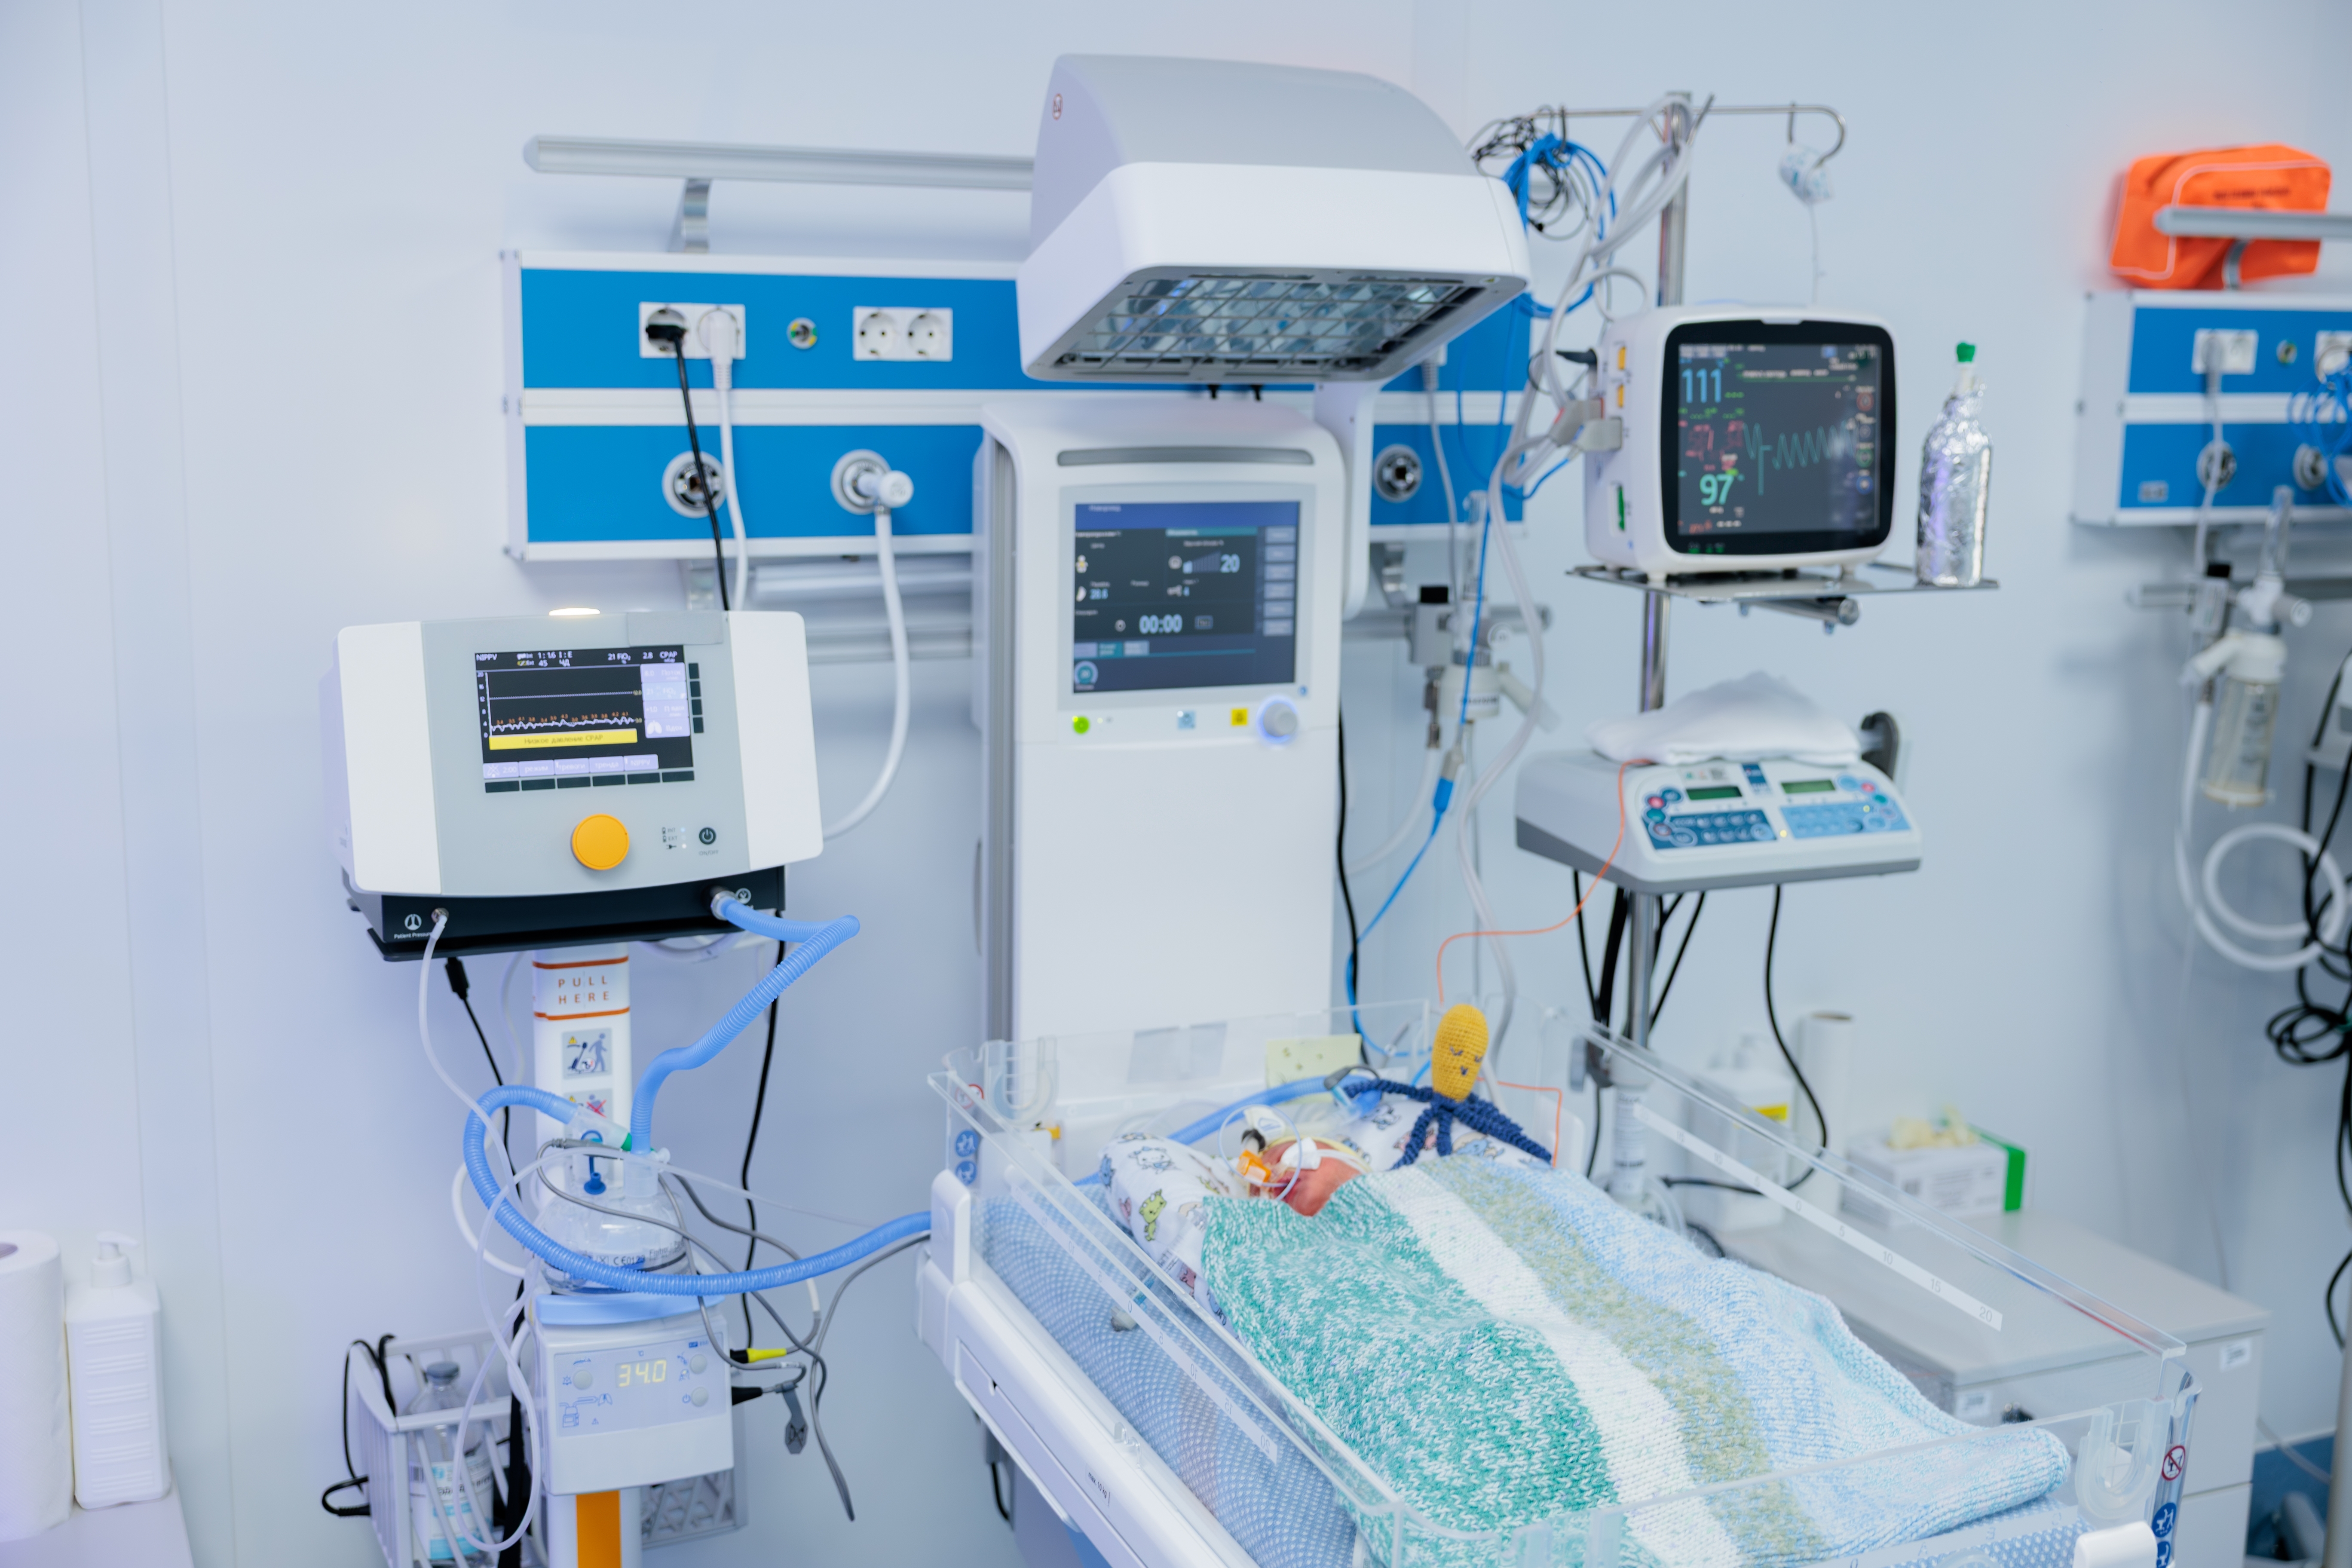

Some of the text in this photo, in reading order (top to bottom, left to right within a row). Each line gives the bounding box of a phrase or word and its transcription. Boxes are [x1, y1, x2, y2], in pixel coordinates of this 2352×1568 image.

[1681, 368, 1722, 404] 111
[1700, 473, 1735, 506] 97
[1220, 554, 1240, 573] 20
[1139, 614, 1183, 634] 00:00
[659, 651, 678, 659] CPAP
[551, 736, 584, 744] давление
[558, 975, 608, 988] PULL
[558, 991, 609, 1005] HERE
[1839, 1225, 1845, 1237] 5
[1883, 1250, 1893, 1265] 10
[1930, 1278, 1941, 1293] 15
[1979, 1306, 1992, 1323] 20
[618, 1360, 667, 1387] 34.0
[1098, 1481, 1102, 1491] 10
[1102, 1486, 1107, 1499] kg
